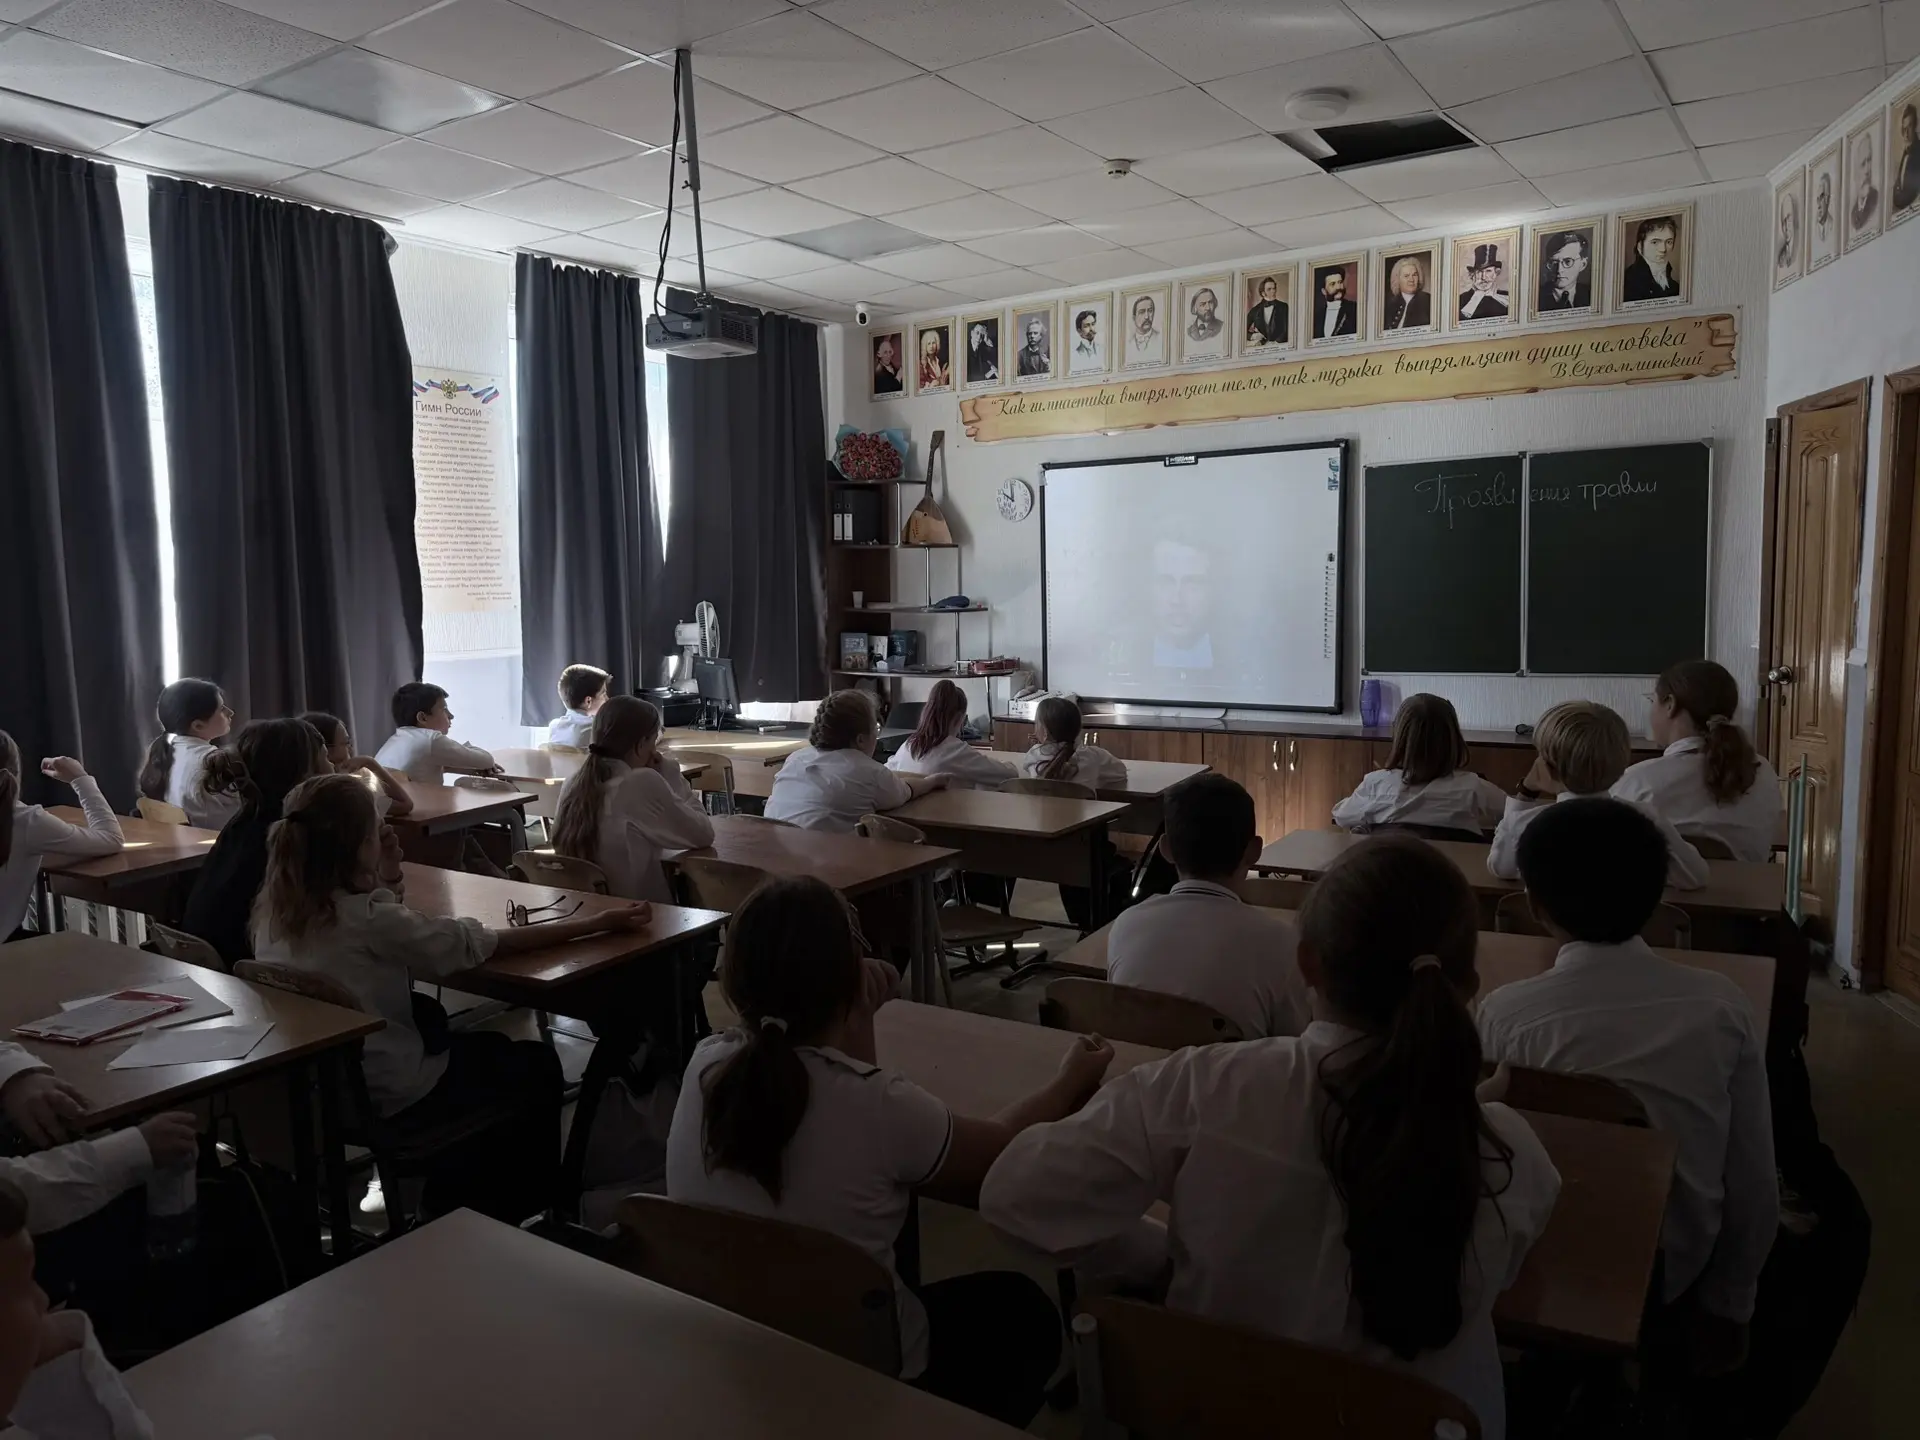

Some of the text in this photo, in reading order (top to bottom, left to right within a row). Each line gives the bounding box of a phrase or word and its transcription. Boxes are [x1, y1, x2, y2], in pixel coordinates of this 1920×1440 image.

[1221, 376, 1268, 393] тело,
[1271, 365, 1309, 387] так
[1311, 358, 1385, 387] музыка
[1394, 348, 1522, 375] выпрямляет
[1526, 340, 1584, 365] душу
[415, 400, 482, 417] Гимн России
[1576, 470, 1658, 511] травли
